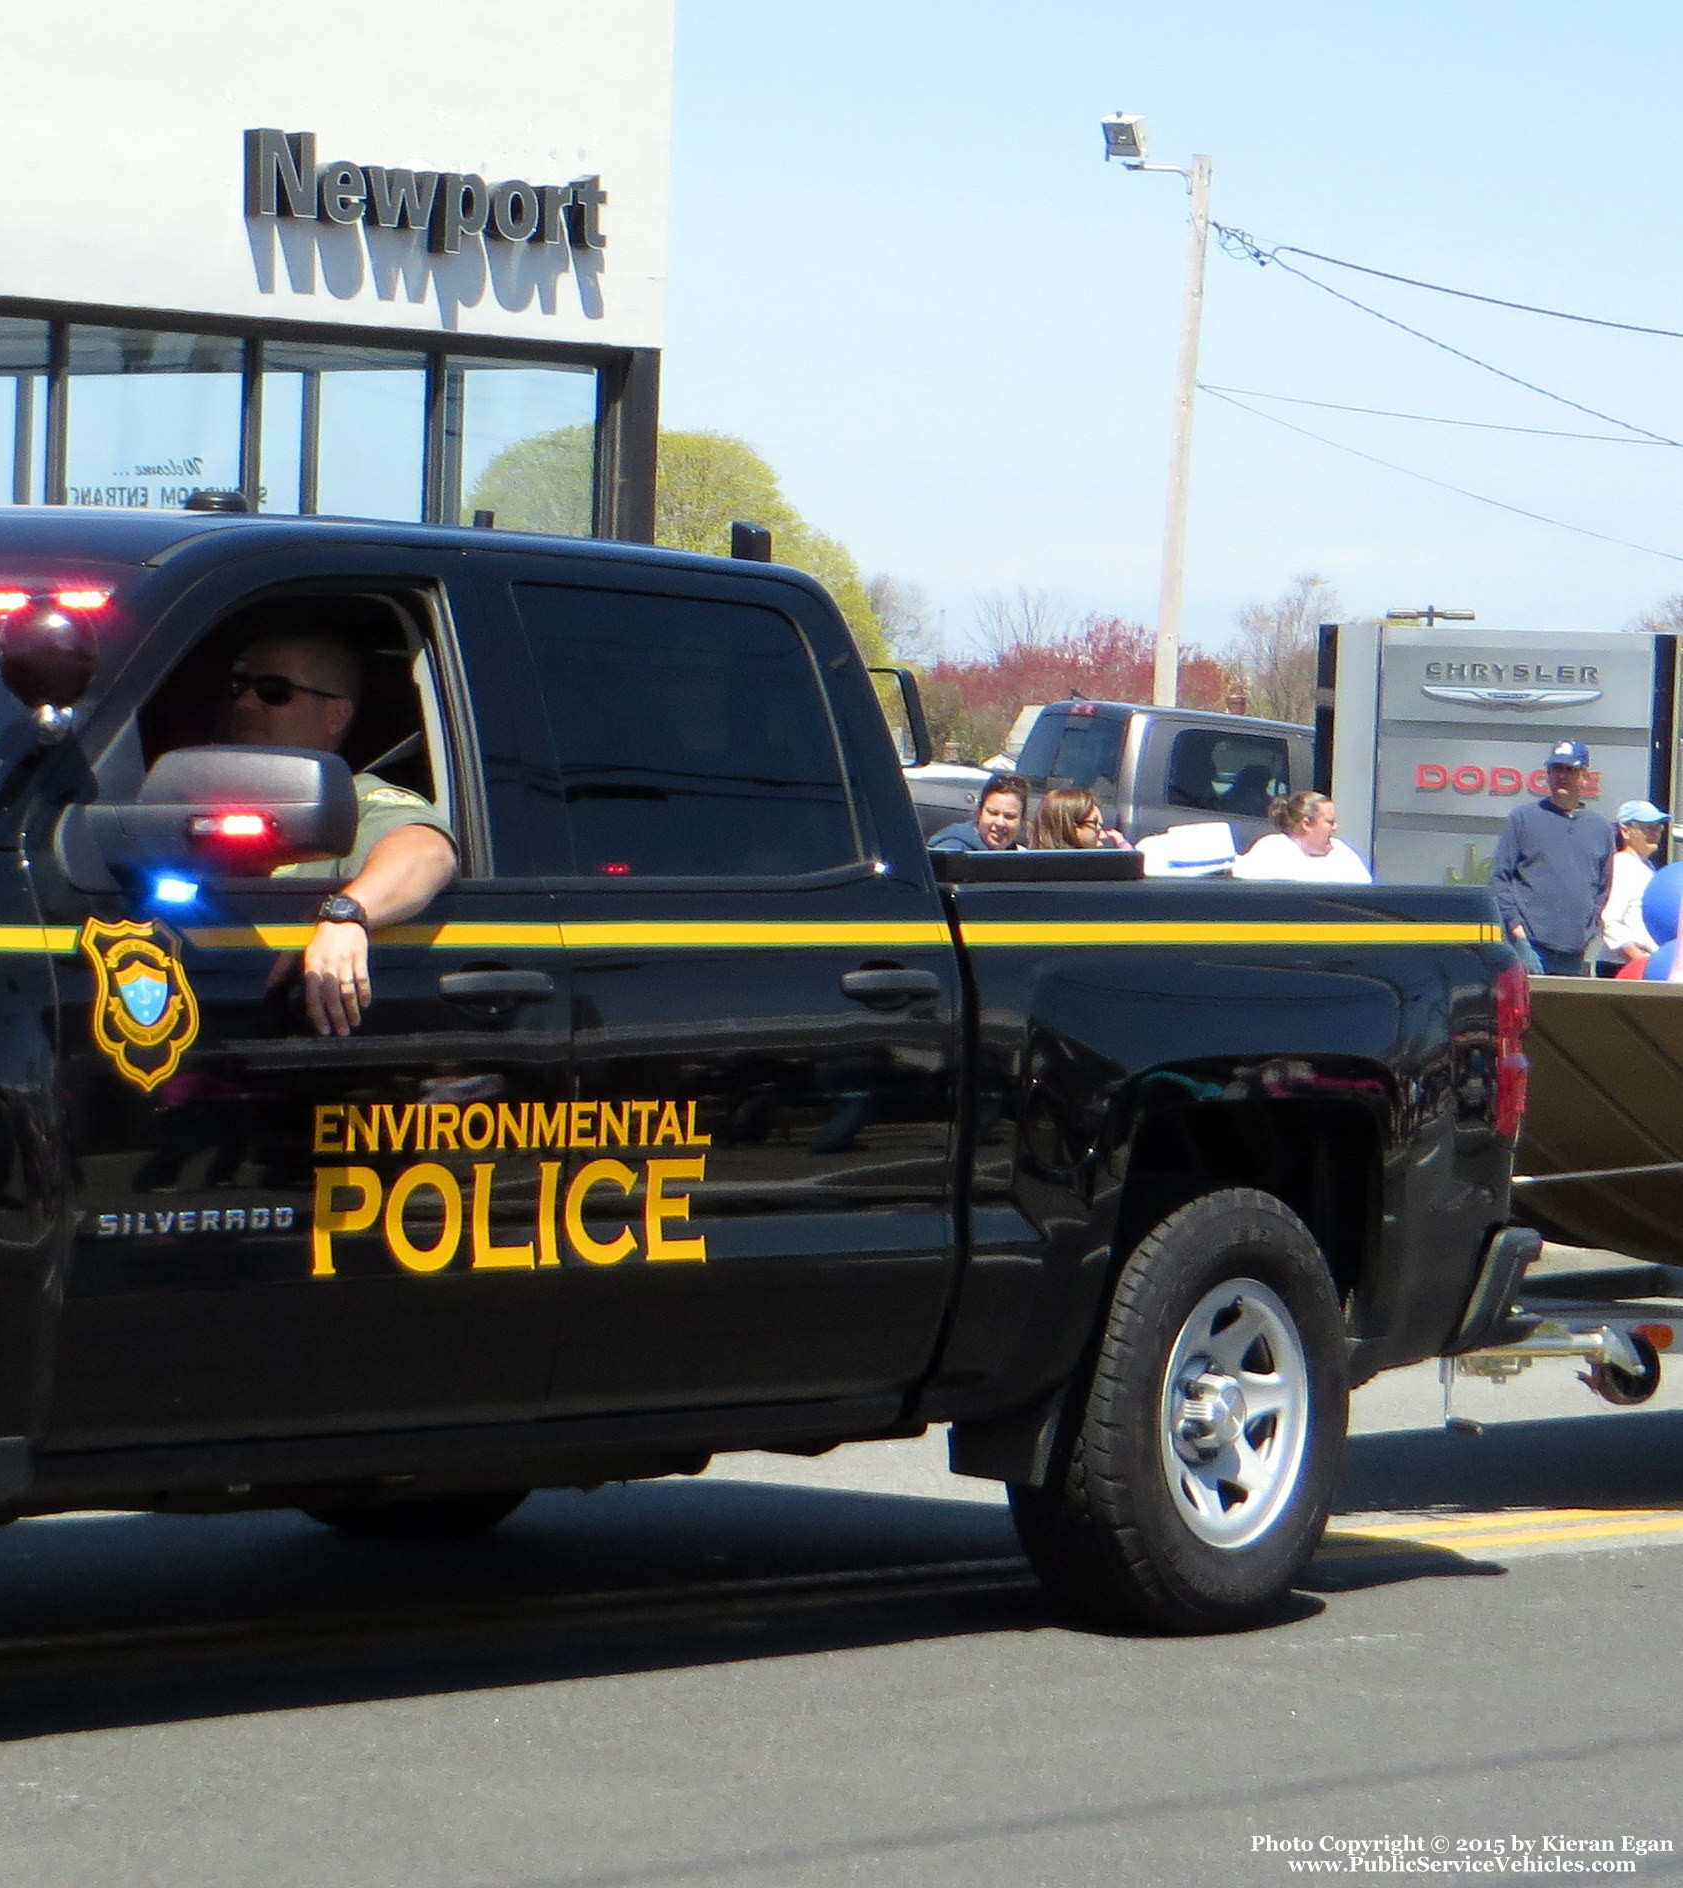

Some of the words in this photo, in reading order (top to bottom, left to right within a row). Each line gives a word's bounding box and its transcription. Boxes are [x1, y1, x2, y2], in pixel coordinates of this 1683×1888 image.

[244, 127, 607, 254] Newport
[1426, 661, 1600, 685] CHRYSLER
[313, 1101, 711, 1154] ENVIRONMENTAL
[98, 1207, 293, 1236] SILVERADO
[310, 1154, 708, 1278] POLICE
